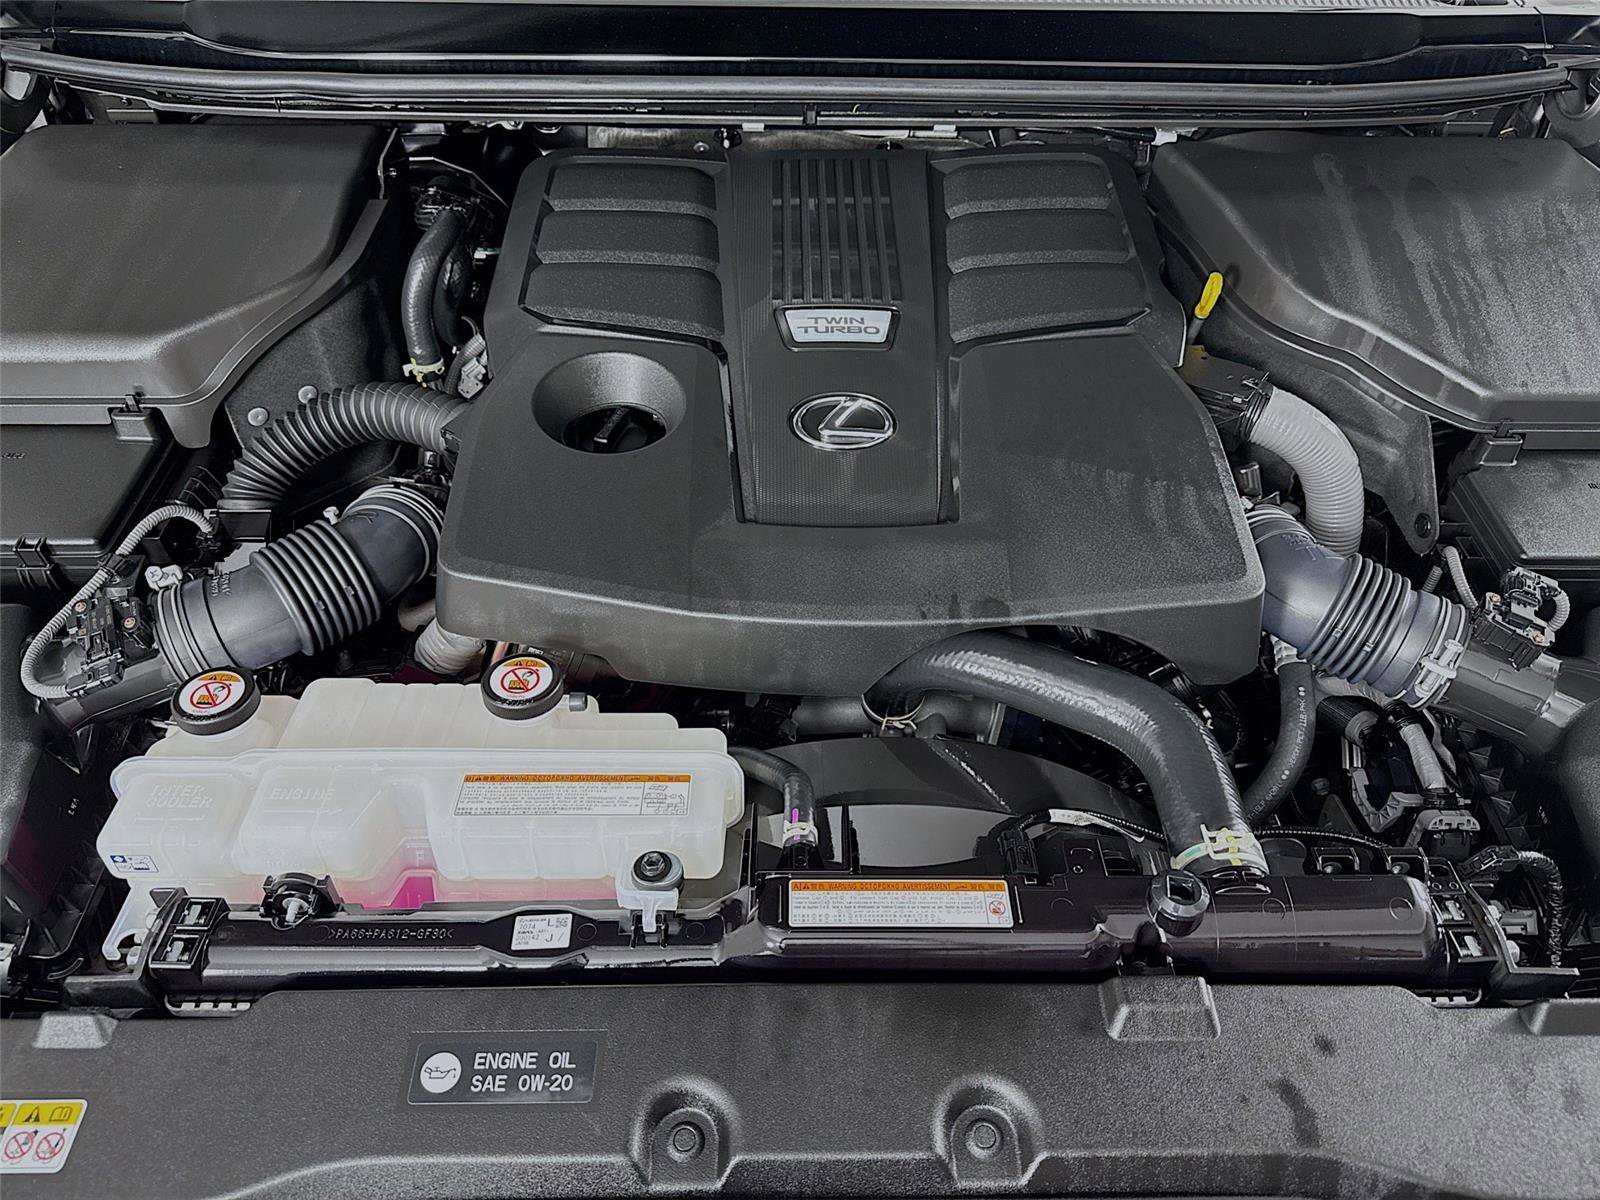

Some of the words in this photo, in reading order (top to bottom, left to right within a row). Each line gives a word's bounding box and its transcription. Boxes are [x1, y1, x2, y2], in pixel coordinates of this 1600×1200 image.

[807, 317, 865, 325] TWIN
[797, 326, 880, 335] TURBO
[474, 1052, 538, 1069] ENGINE
[549, 1052, 576, 1069] OIL
[471, 1075, 508, 1092] SAE
[518, 1074, 573, 1092] 0W-20
